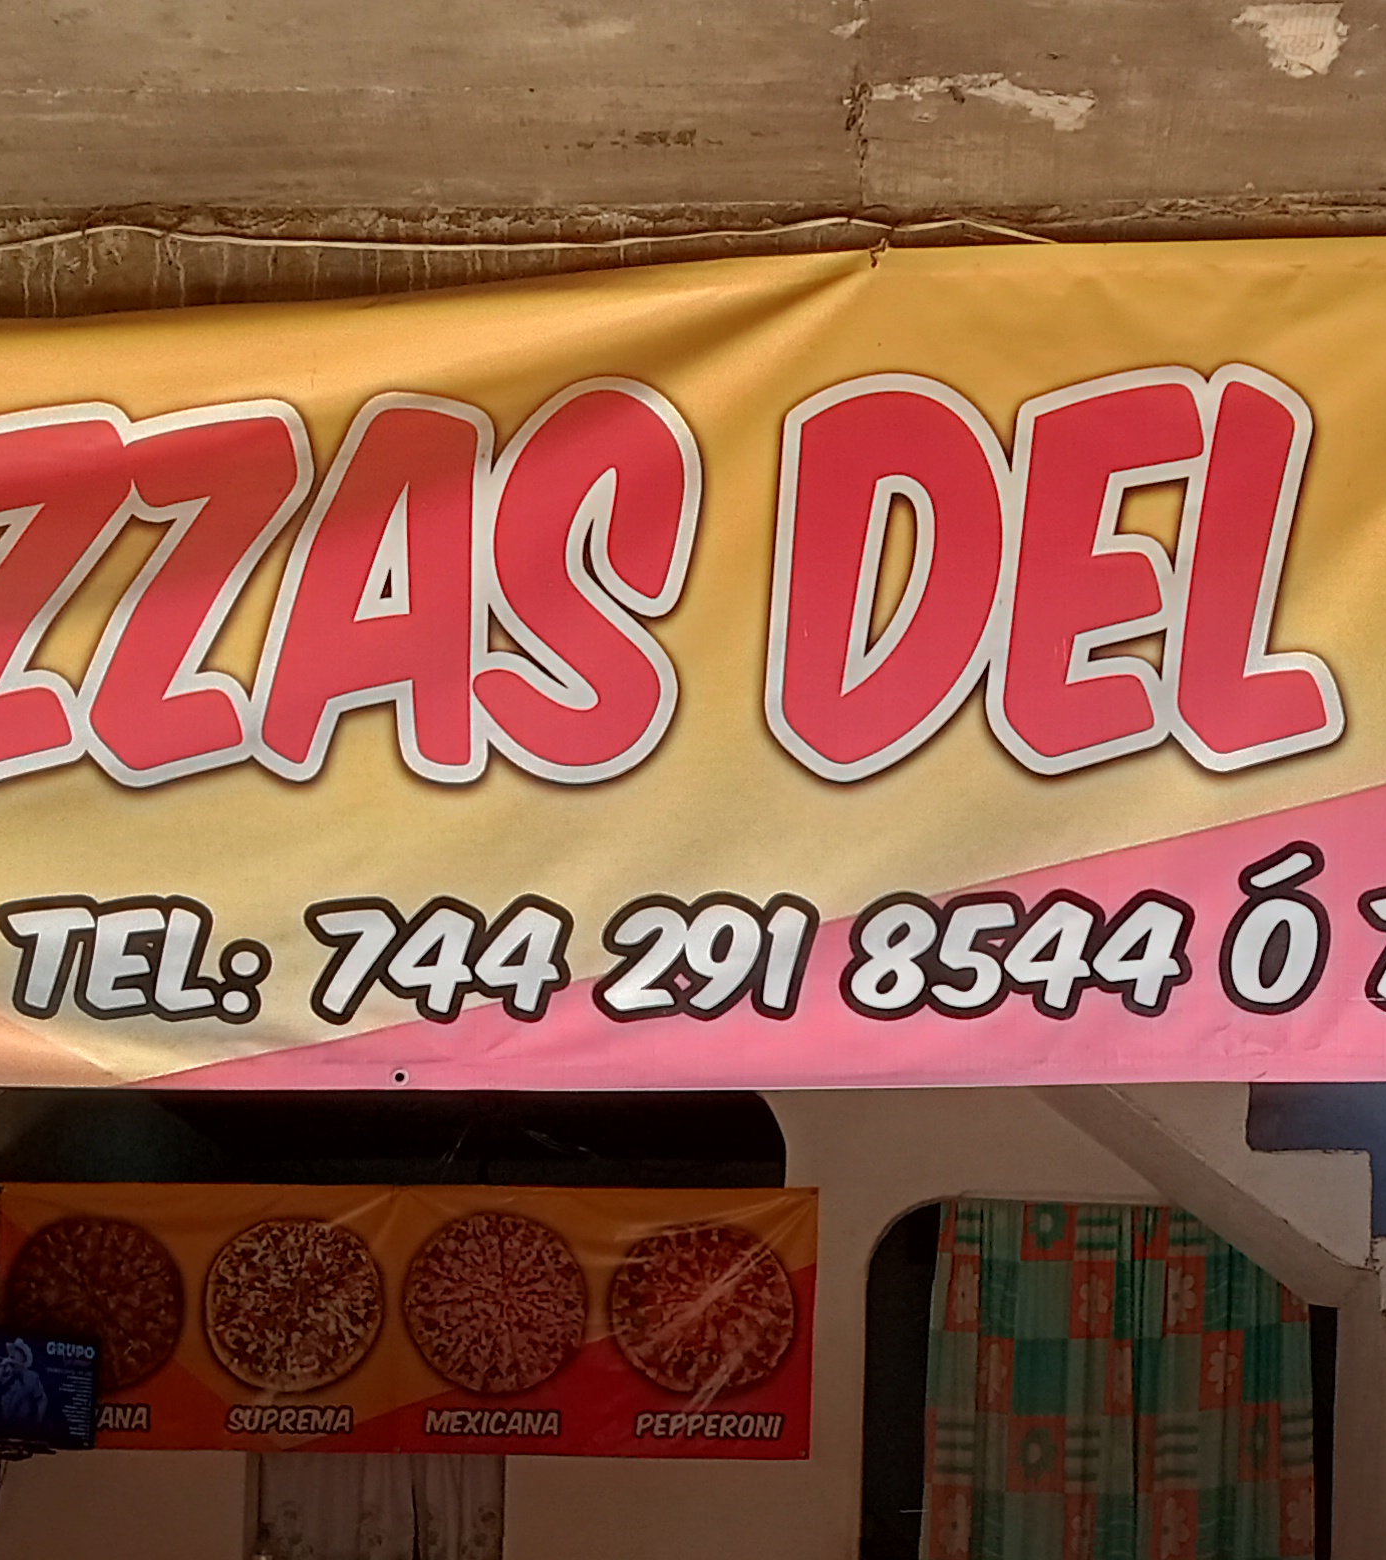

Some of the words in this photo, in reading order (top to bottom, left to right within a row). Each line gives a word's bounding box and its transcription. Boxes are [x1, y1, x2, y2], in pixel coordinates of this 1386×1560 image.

[764, 364, 1345, 782] DEL
[0, 896, 271, 1022] TEL:
[307, 896, 575, 1023] 744
[602, 892, 818, 1021] 291
[844, 891, 1193, 1018] 8544
[1223, 842, 1329, 1012] Ó
[46, 1341, 96, 1360] GRUPO
[94, 1404, 150, 1431] ANA
[226, 1406, 352, 1435] SUPREMA
[425, 1409, 560, 1437] MEXICANA
[634, 1411, 783, 1441] PEPPERONI
